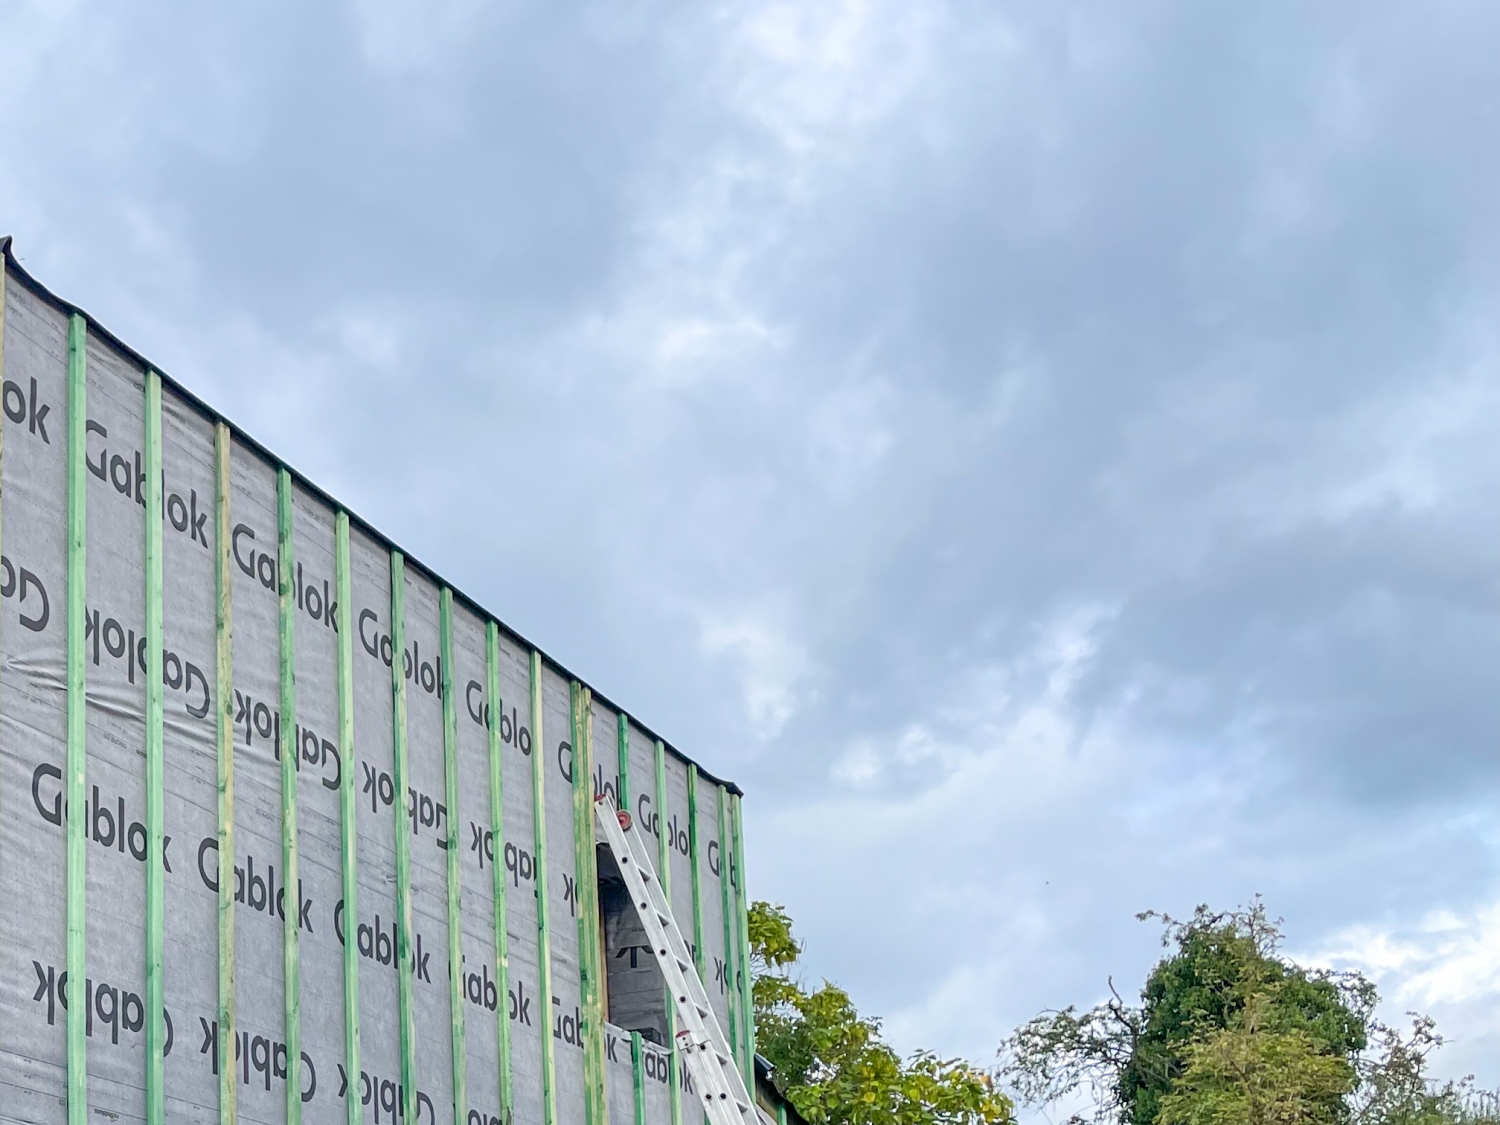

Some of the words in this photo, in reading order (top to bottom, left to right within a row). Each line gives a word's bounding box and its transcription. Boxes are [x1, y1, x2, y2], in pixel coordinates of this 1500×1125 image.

[233, 523, 338, 634] Galok
[234, 688, 342, 791] Galok
[200, 1016, 316, 1102] Gablk
